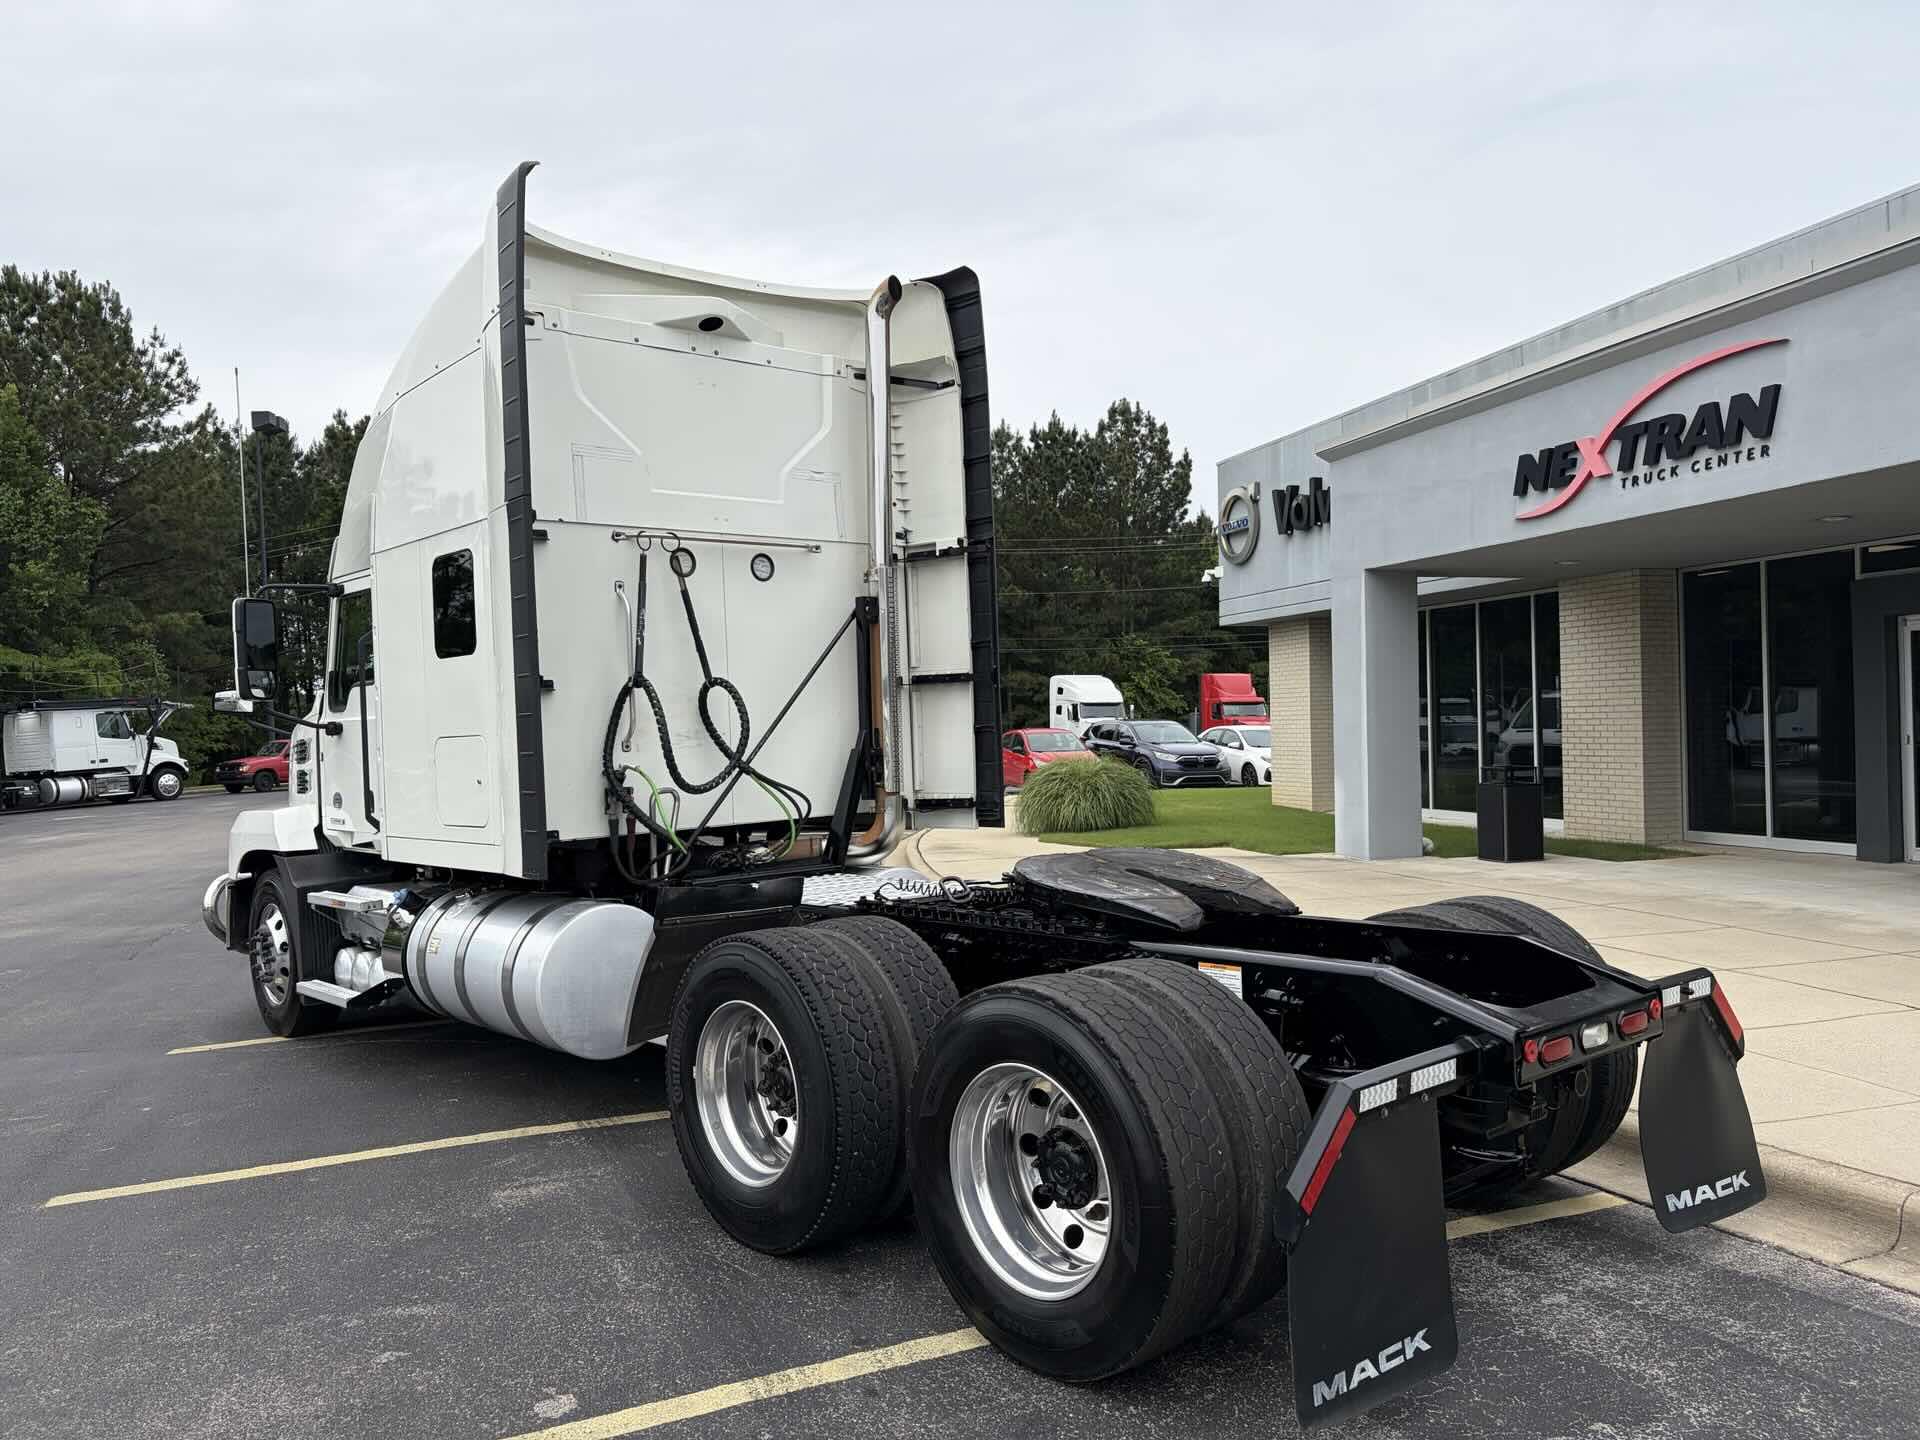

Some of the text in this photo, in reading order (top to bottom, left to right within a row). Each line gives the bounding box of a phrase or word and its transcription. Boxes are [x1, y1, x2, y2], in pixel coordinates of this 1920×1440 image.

[1513, 384, 1782, 497] NEXTRAN
[1620, 444, 1771, 489] TRUCK CENTER
[1222, 516, 1249, 533] VOLVO
[1665, 1169, 1751, 1213] MACK
[1312, 1327, 1433, 1408] MACK
